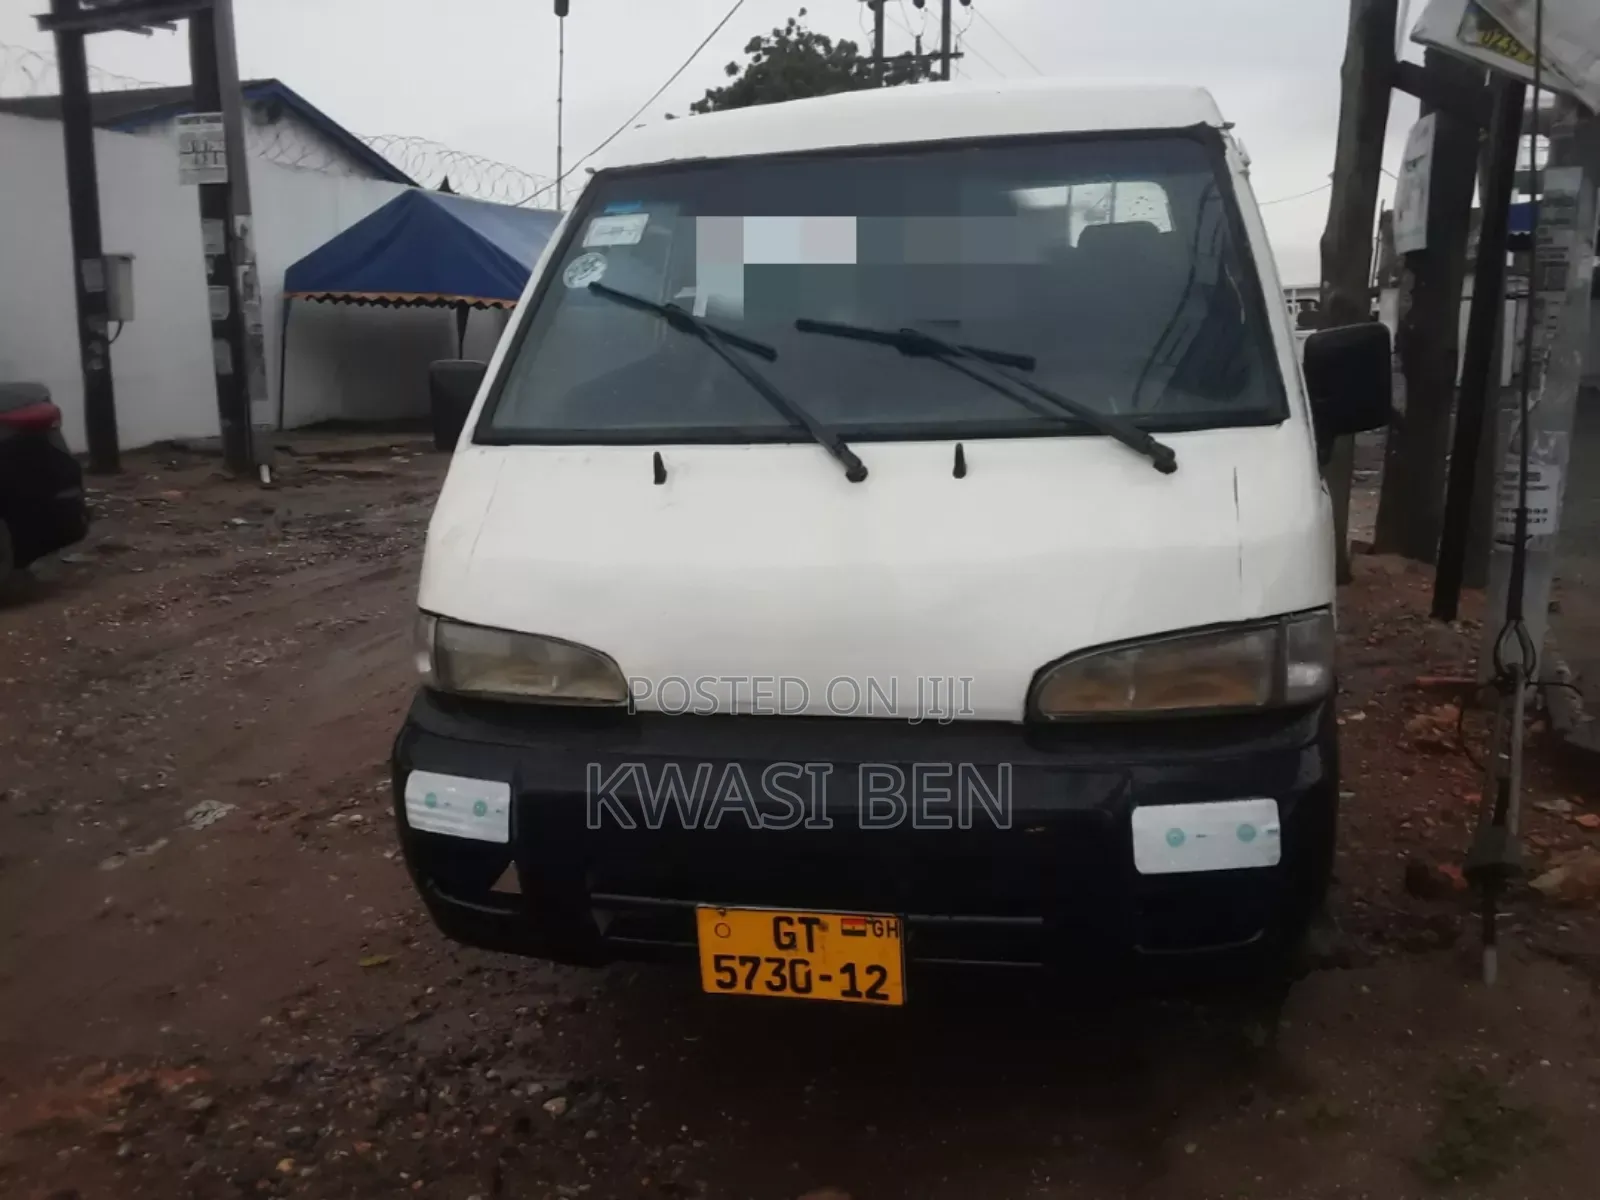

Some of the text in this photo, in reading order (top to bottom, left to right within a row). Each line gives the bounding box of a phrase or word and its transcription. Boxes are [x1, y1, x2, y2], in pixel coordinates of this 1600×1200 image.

[772, 916, 820, 953] GT
[872, 920, 899, 938] GH
[713, 954, 890, 1001] 5730-12
